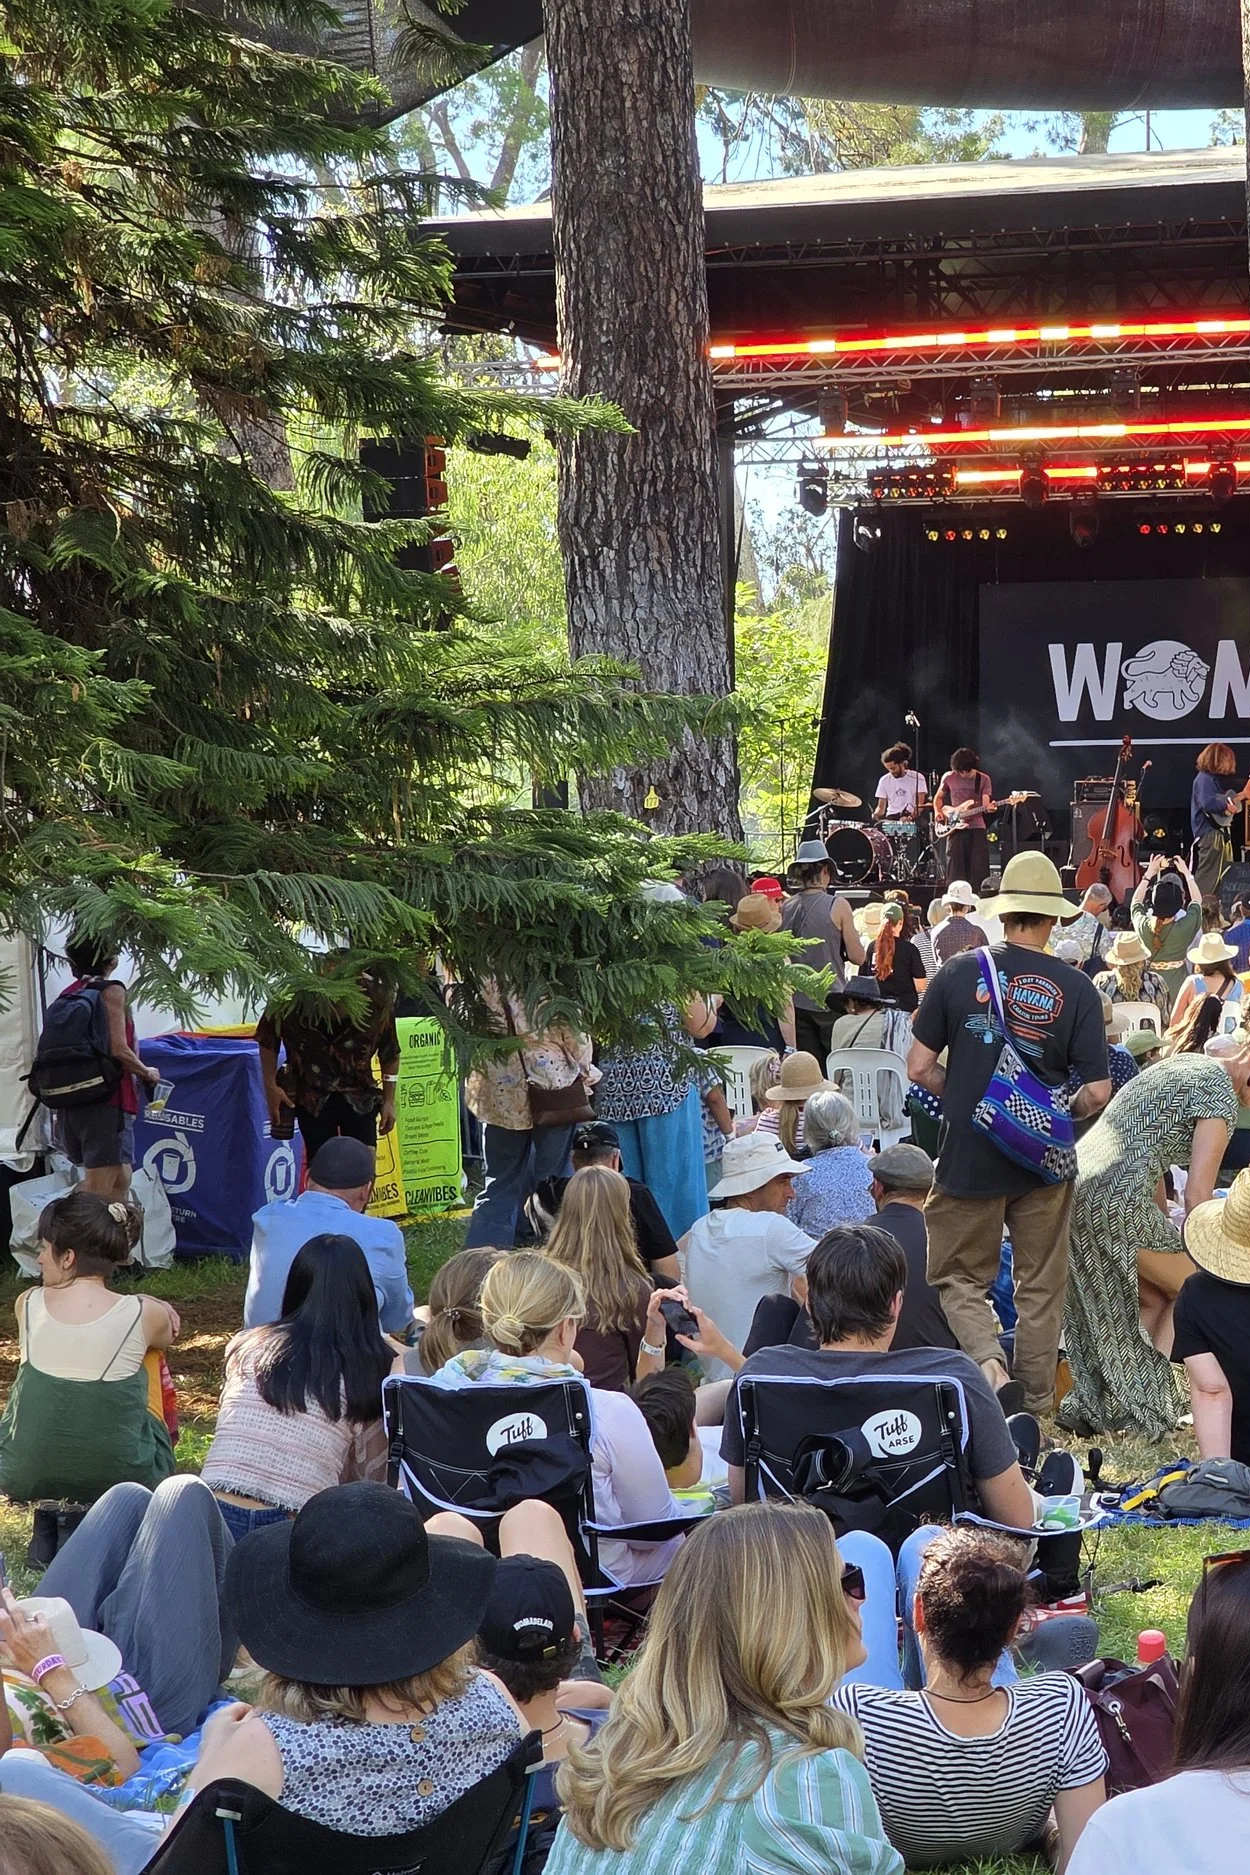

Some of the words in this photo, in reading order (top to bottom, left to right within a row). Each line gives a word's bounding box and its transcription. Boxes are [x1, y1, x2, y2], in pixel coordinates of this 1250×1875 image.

[1012, 986, 1054, 1012] HAVANA
[172, 1206, 197, 1218] ETURN
[500, 1416, 533, 1444] Tuff
[873, 1413, 908, 1441] Tuff
[889, 1435, 915, 1448] ARSE
